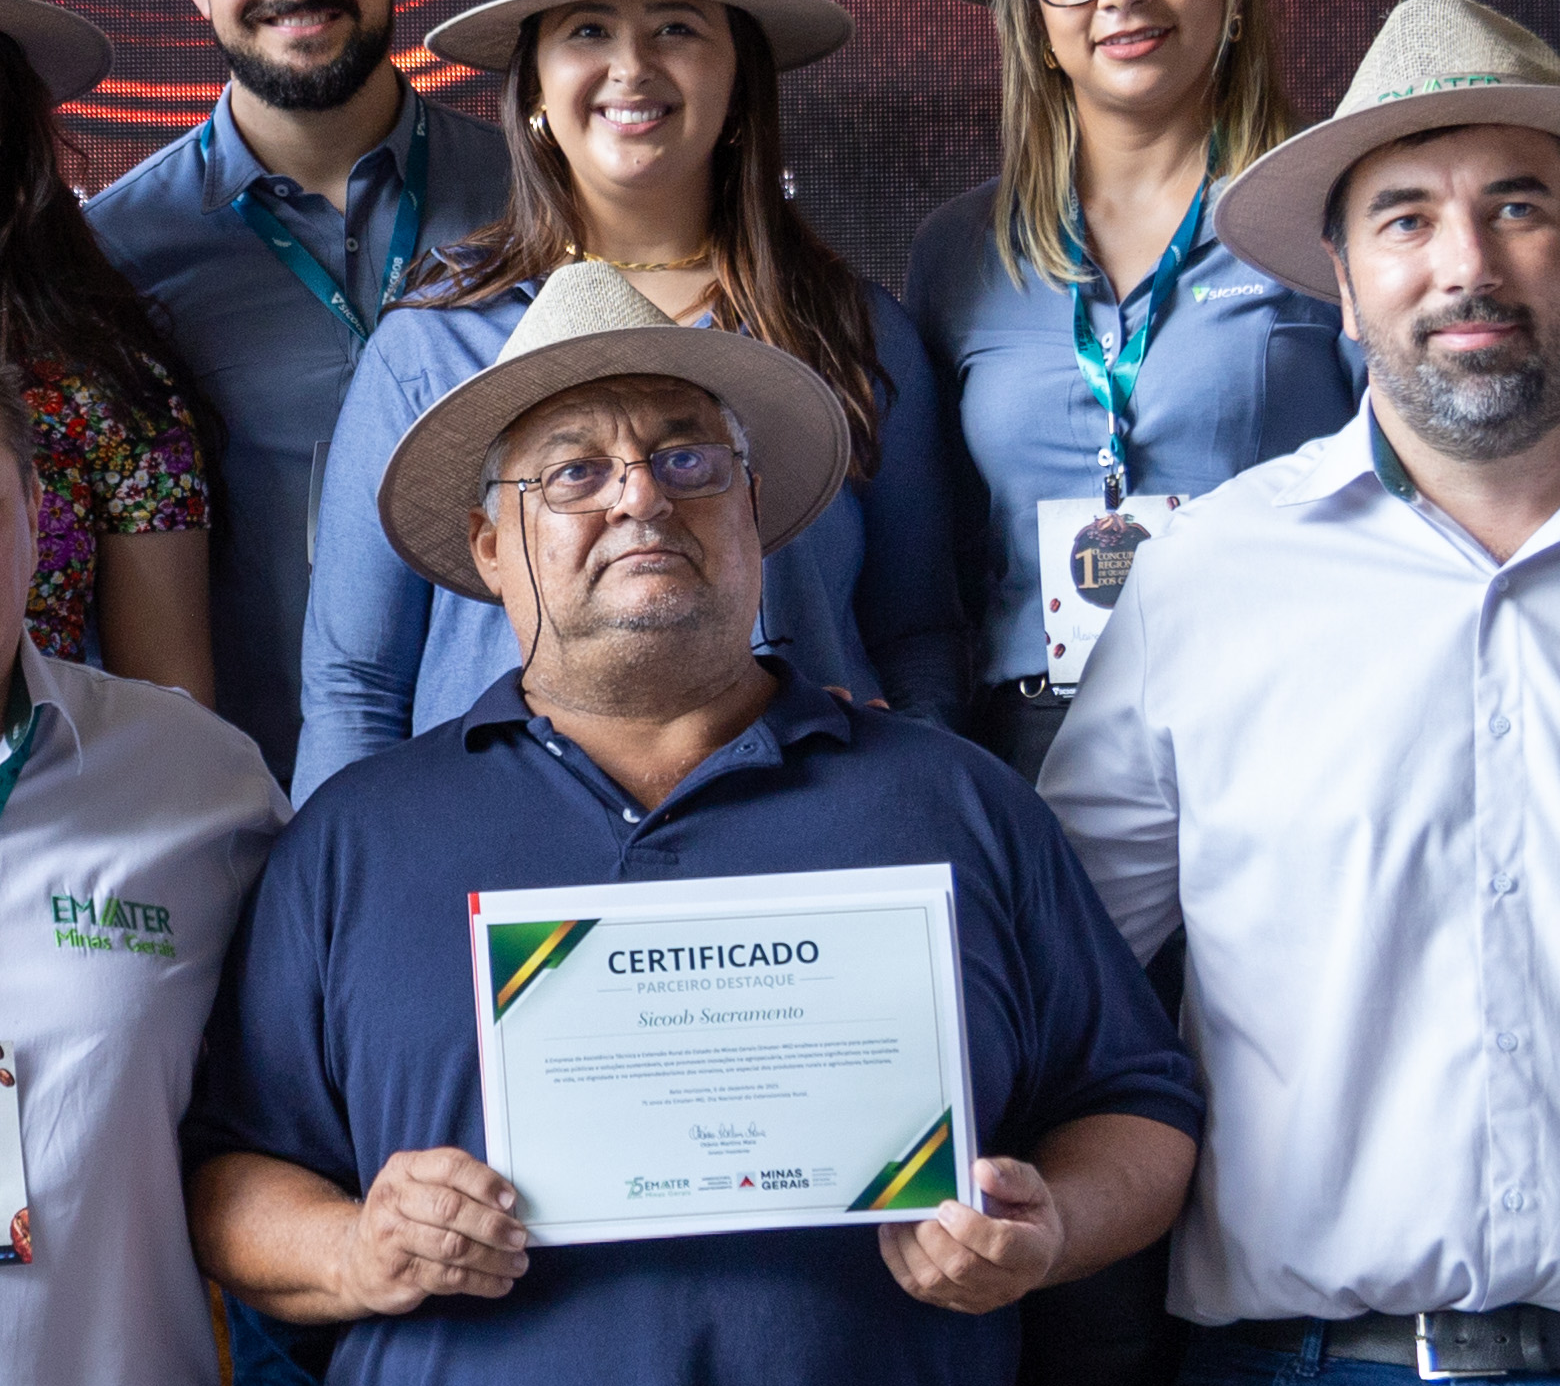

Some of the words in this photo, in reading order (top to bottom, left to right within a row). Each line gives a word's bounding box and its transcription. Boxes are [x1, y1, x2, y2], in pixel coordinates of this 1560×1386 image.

[1208, 284, 1264, 301] SICOOB
[52, 896, 174, 935] EMATER
[55, 928, 112, 951] Minas
[125, 934, 177, 959] Gerais
[607, 939, 820, 976] CERTIFICADO
[637, 978, 712, 995] PARCEIRO
[716, 973, 795, 991] DESTAQUE
[637, 1008, 695, 1028] Sicoob
[699, 1004, 805, 1026] Sacramento
[760, 1168, 803, 1180] MINAS
[761, 1178, 810, 1190] GERAIS
